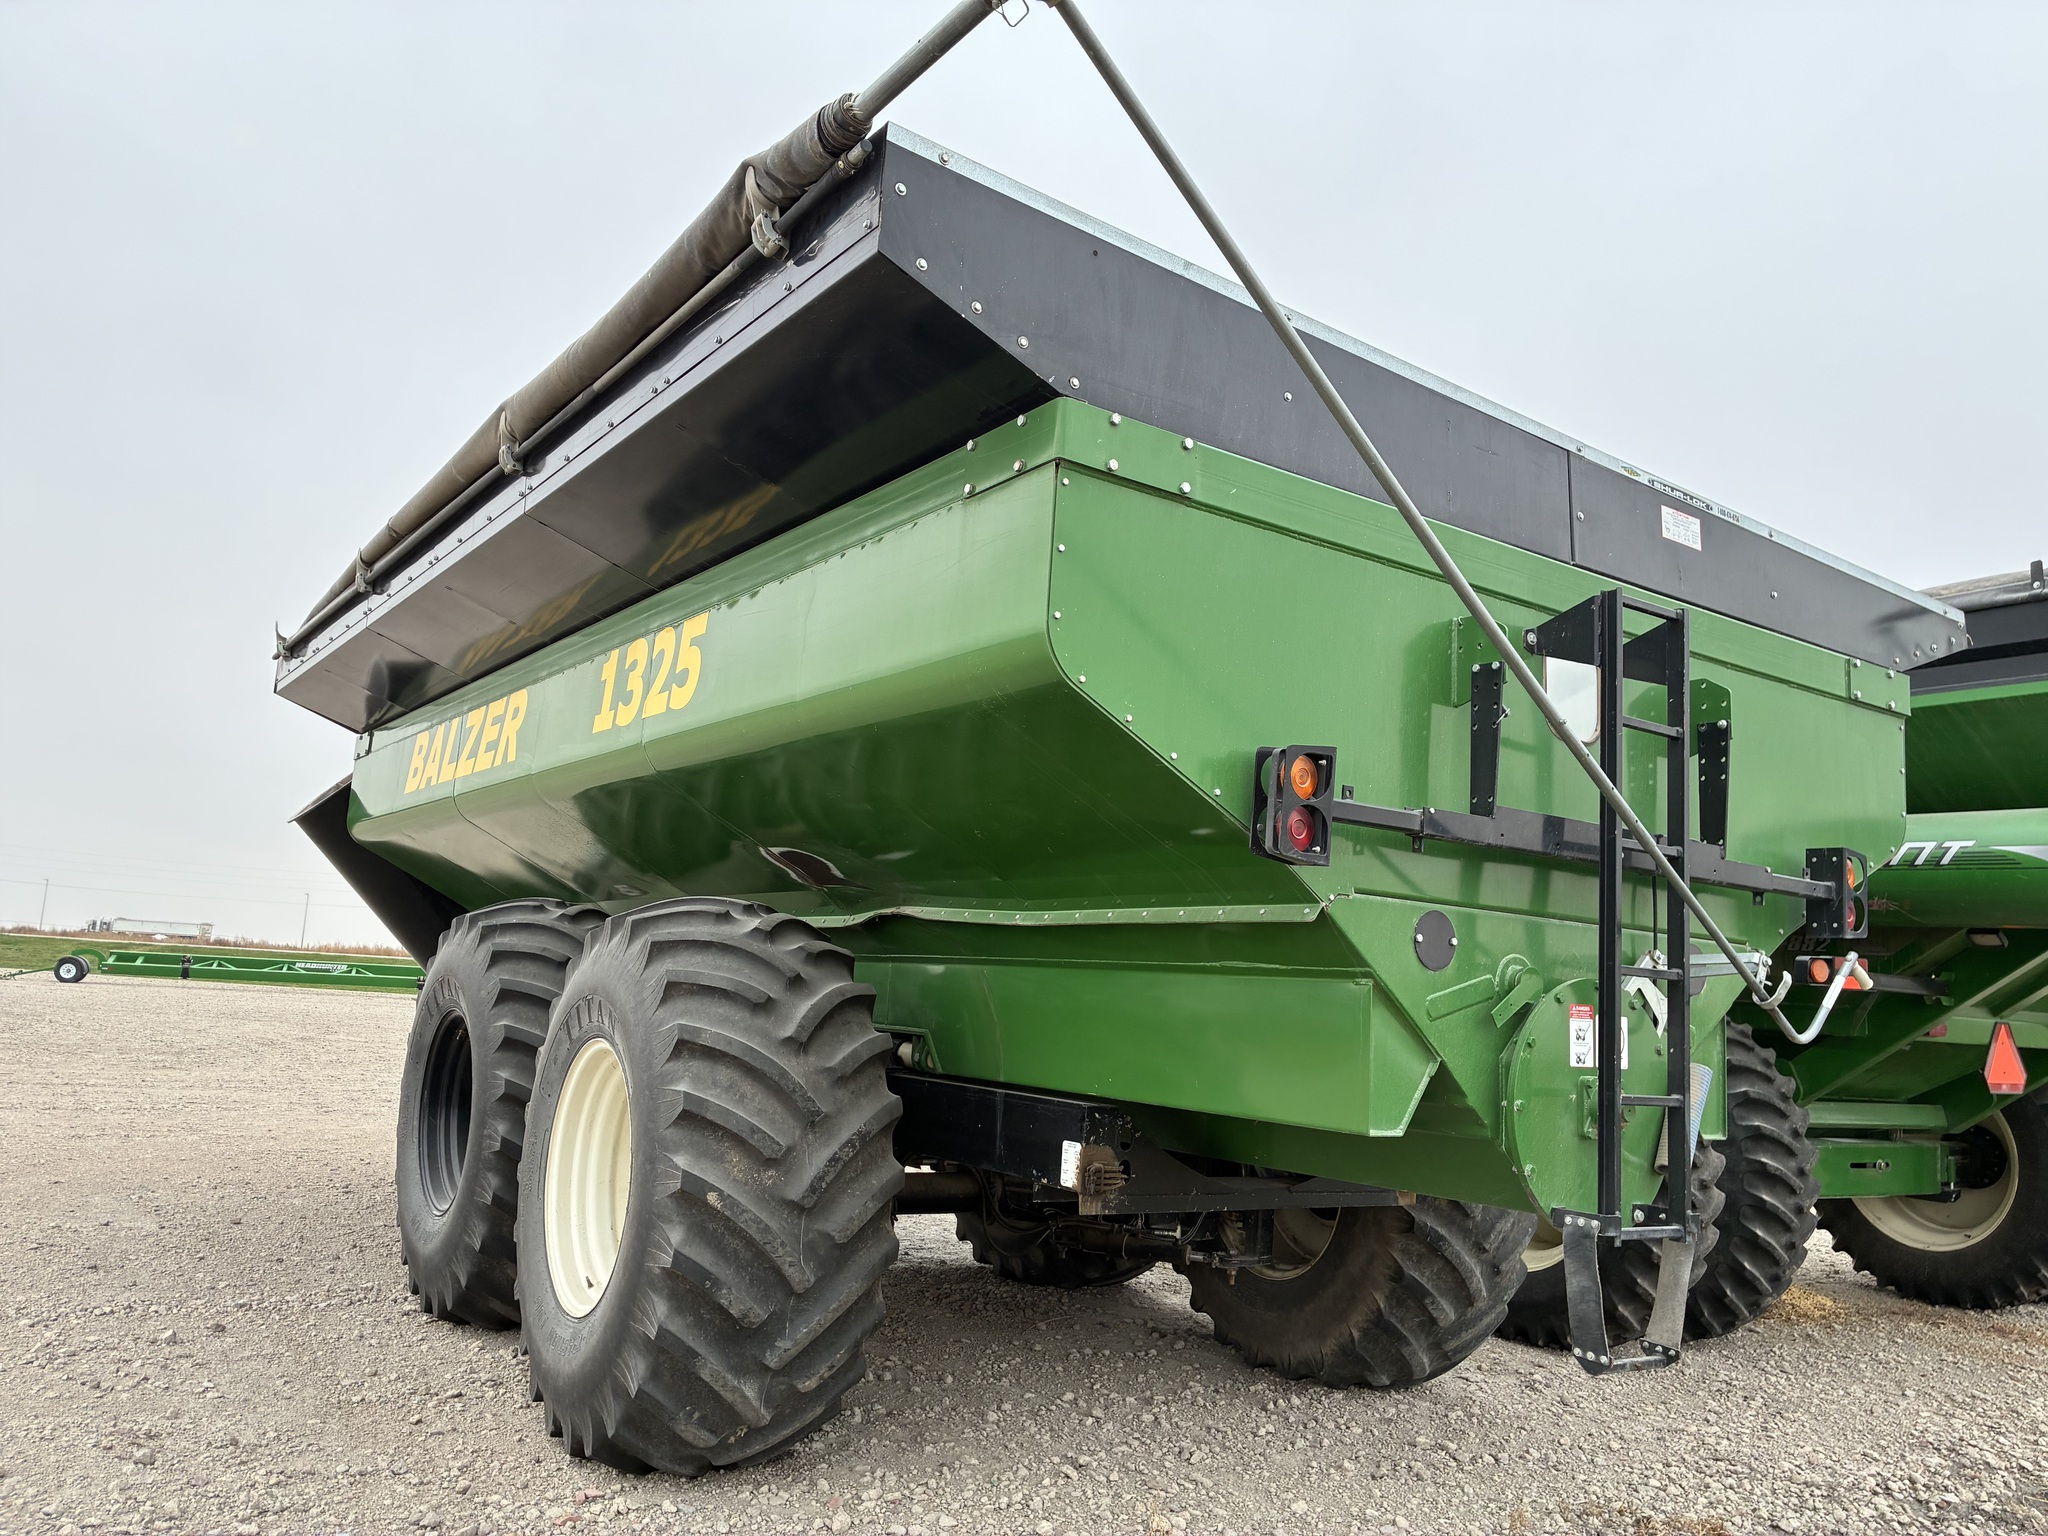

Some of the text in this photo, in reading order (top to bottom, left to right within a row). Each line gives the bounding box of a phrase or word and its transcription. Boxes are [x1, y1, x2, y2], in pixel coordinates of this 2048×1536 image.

[1653, 481, 1708, 510] SHUR-LOK
[404, 610, 709, 794] BALZER 1325
[421, 975, 465, 1020] TITAN
[560, 994, 622, 1045] TITAN
